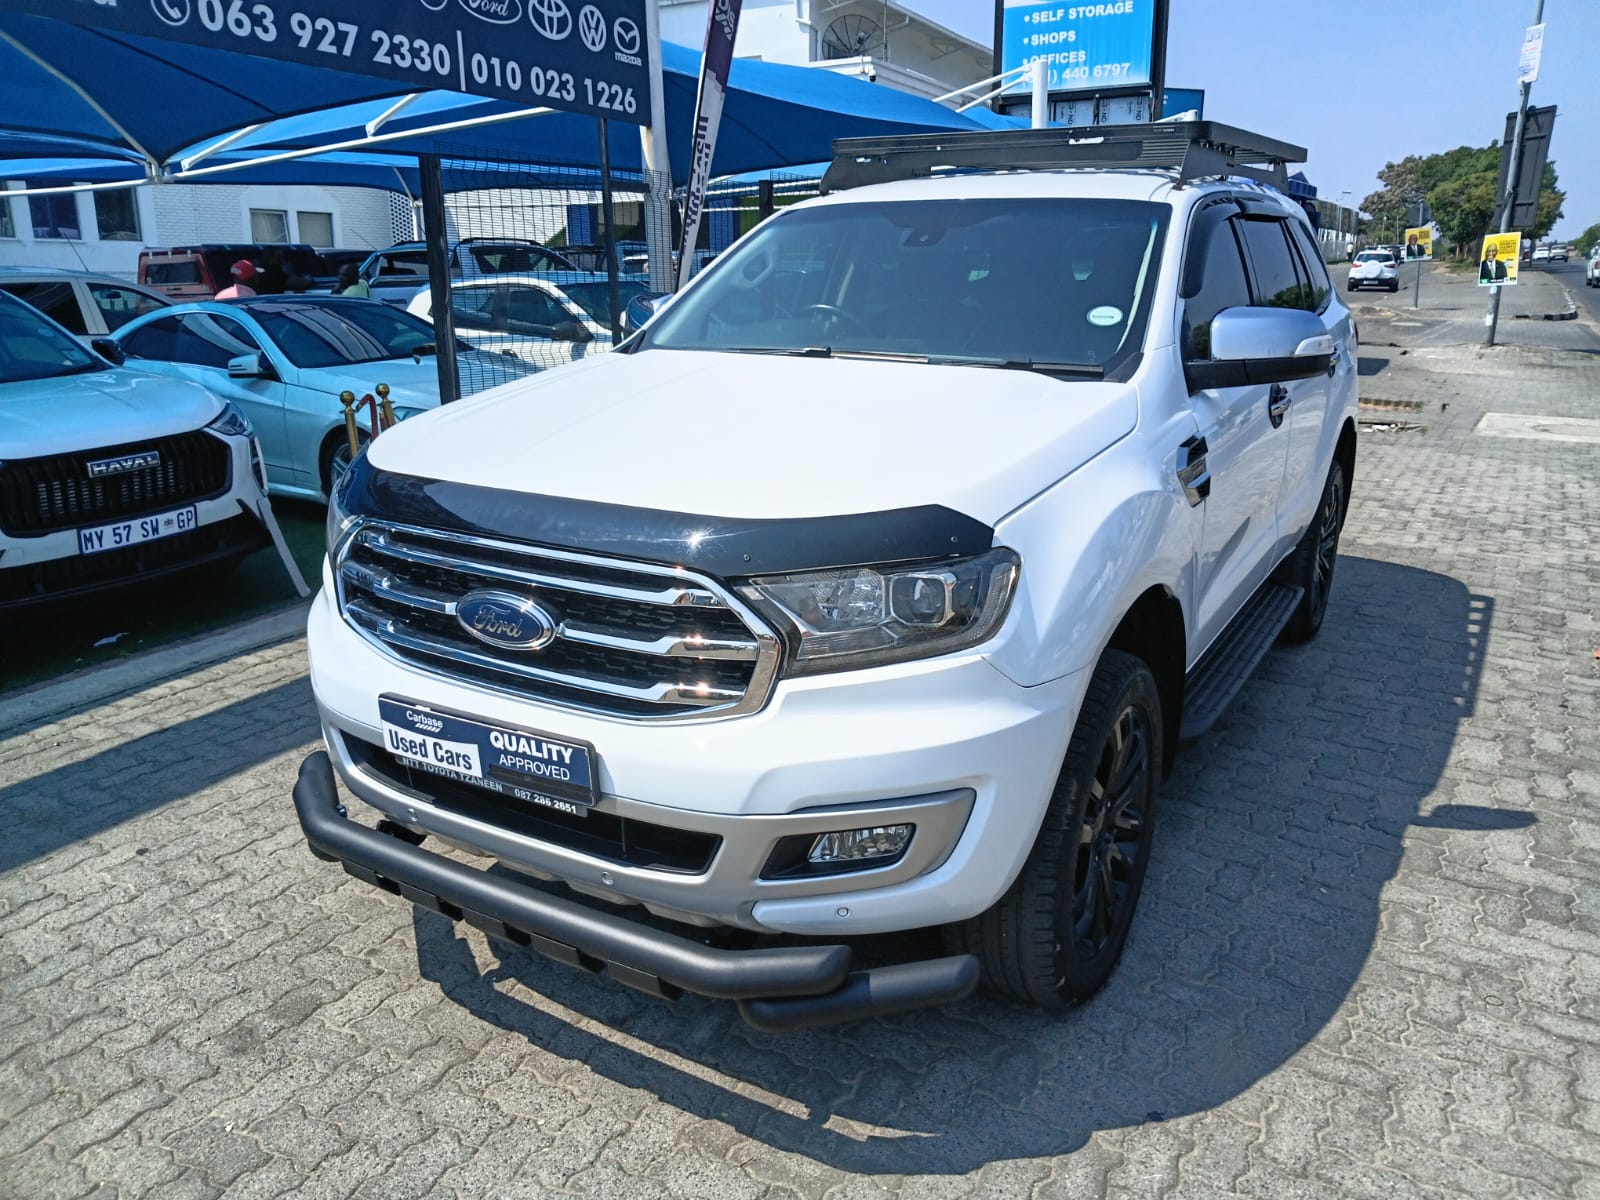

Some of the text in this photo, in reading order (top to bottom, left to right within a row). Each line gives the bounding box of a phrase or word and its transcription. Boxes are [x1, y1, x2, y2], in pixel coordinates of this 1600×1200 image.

[1031, 1, 1134, 24] SELF STORAGE
[1030, 30, 1076, 46] SHOPS
[197, 0, 637, 114] 063 927 2330 010 023 1226
[615, 51, 642, 66] mazda
[1062, 66, 1089, 81] 440
[1093, 62, 1131, 78] 6797
[92, 454, 159, 474] HAVAL
[83, 509, 194, 552] MY 57 SW GP
[472, 604, 523, 638] Ford
[406, 710, 443, 728] Carbase
[388, 728, 473, 771] Used Cars
[489, 731, 574, 765] QUALITY
[499, 754, 570, 781] APPROVED
[421, 763, 457, 779] TOYOTA
[459, 772, 503, 792] TZANEEN
[514, 788, 531, 800] 087
[553, 800, 577, 814] 2651
